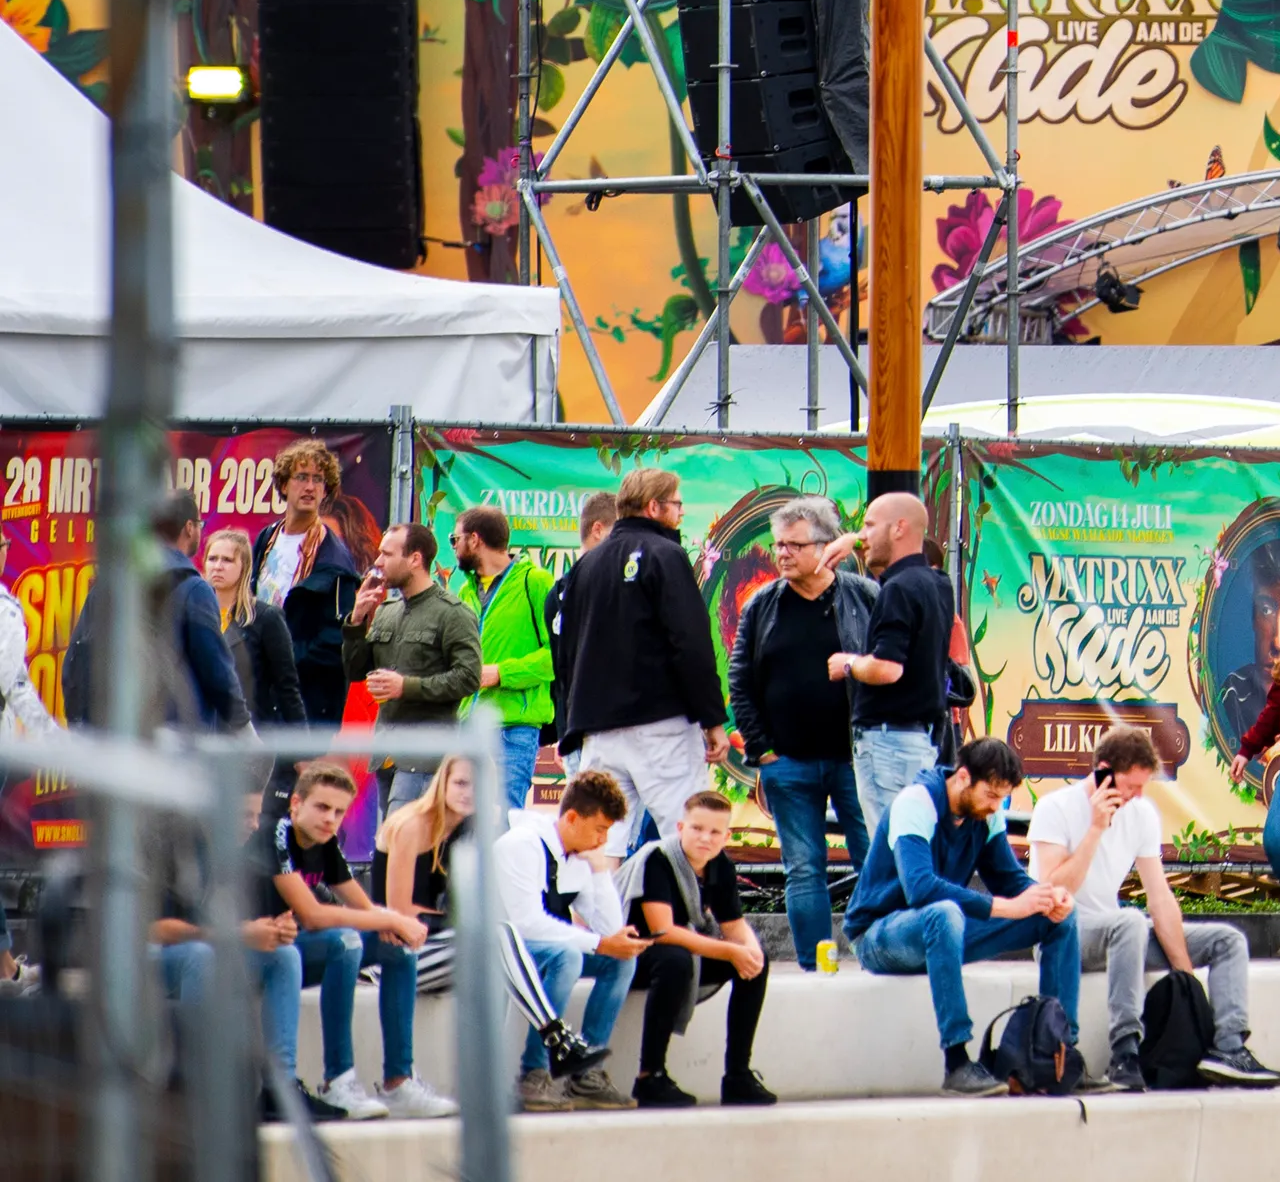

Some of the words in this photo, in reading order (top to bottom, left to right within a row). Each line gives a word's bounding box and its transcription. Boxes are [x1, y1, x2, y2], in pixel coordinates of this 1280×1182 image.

[1056, 20, 1099, 43] LIVE
[1135, 21, 1177, 43] AAN
[1178, 21, 1204, 42] DE
[4, 456, 42, 507] 28
[1030, 501, 1107, 529] ZONDAG
[1111, 503, 1129, 529] 14
[1131, 504, 1174, 530] JULI
[1018, 552, 1188, 614] MATRIXX
[1107, 608, 1128, 625] LIVE
[1145, 609, 1165, 625] AAN
[1165, 610, 1179, 626] DE
[1043, 723, 1076, 753] LIL
